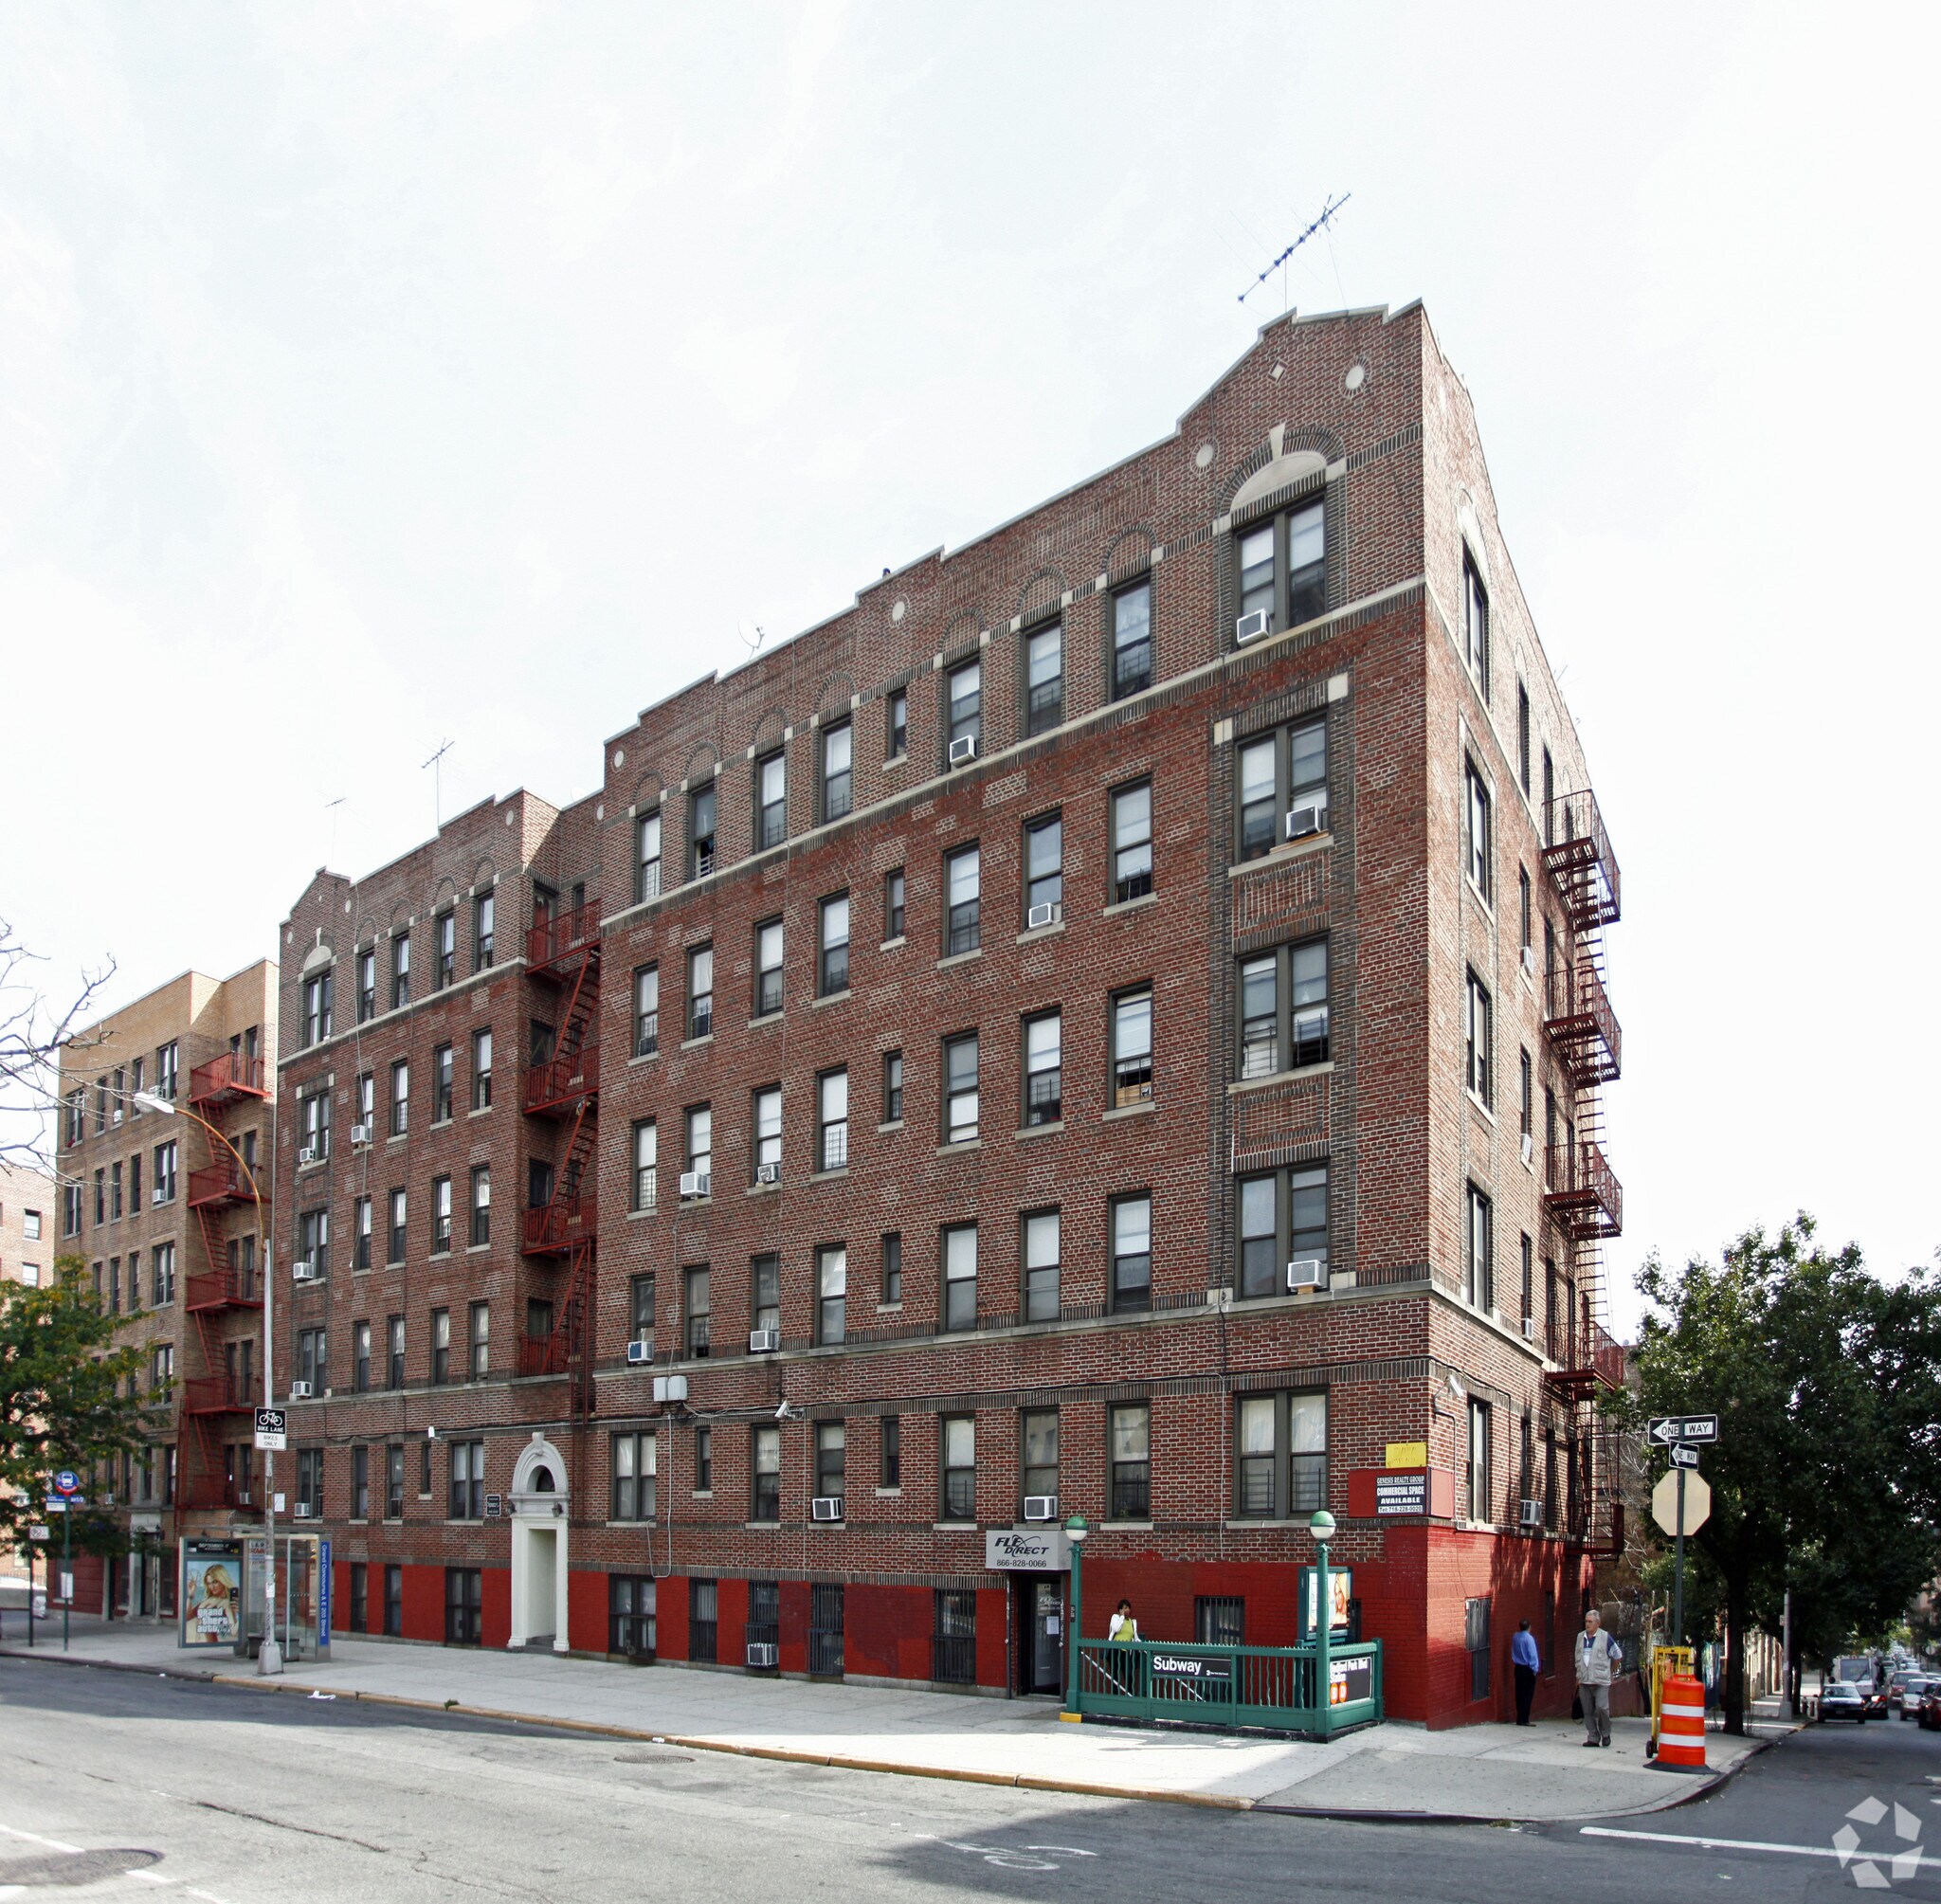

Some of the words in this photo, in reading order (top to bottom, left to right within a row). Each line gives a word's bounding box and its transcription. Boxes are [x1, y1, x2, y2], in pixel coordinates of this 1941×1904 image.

[1661, 1425, 1678, 1436] ONE
[1688, 1423, 1709, 1434] WAY
[1675, 1449, 1683, 1460] ONE
[1687, 1452, 1696, 1460] WAY
[1377, 1486, 1408, 1496] COMMERCIAL
[1408, 1485, 1424, 1496] SPACE
[996, 1559, 1046, 1568] 866-828-0066
[197, 1607, 223, 1619] grand
[197, 1624, 218, 1633] auto
[1153, 1657, 1202, 1676] Subway
